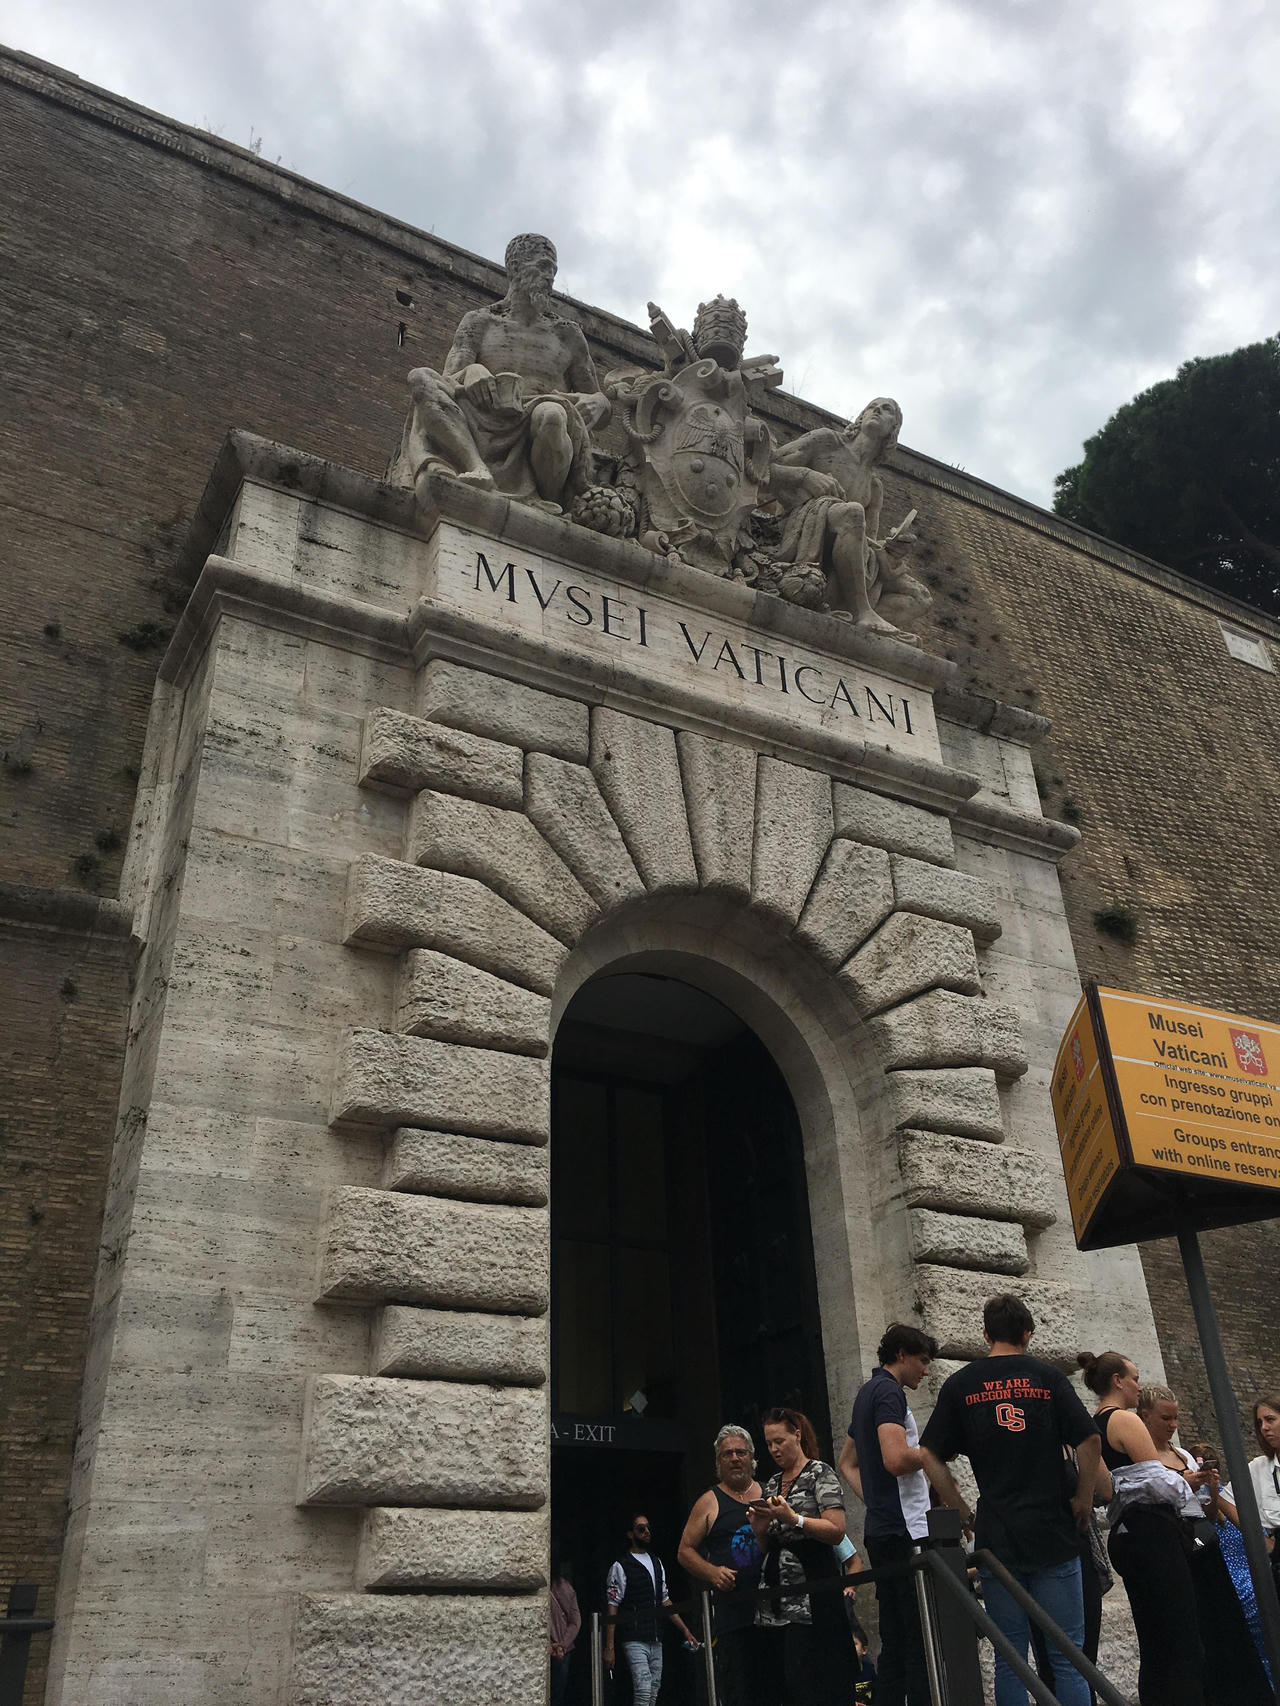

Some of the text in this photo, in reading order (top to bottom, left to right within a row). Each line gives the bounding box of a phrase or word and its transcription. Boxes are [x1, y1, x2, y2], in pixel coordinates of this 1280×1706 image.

[473, 551, 915, 736] MVSEI VATICANI
[1148, 1012, 1204, 1039] Musei
[1152, 1038, 1228, 1069] Vaticani
[1164, 1074, 1273, 1108] Ingresso gruppi
[1140, 1093, 1167, 1107] con
[1171, 1098, 1261, 1124] prenotazione
[1173, 1128, 1227, 1151] Groups
[1152, 1147, 1280, 1179] with online reserv
[965, 1388, 1051, 1406] OREGON STATE
[983, 1378, 1030, 1391] WE ARE
[574, 1423, 616, 1442] EXIT
